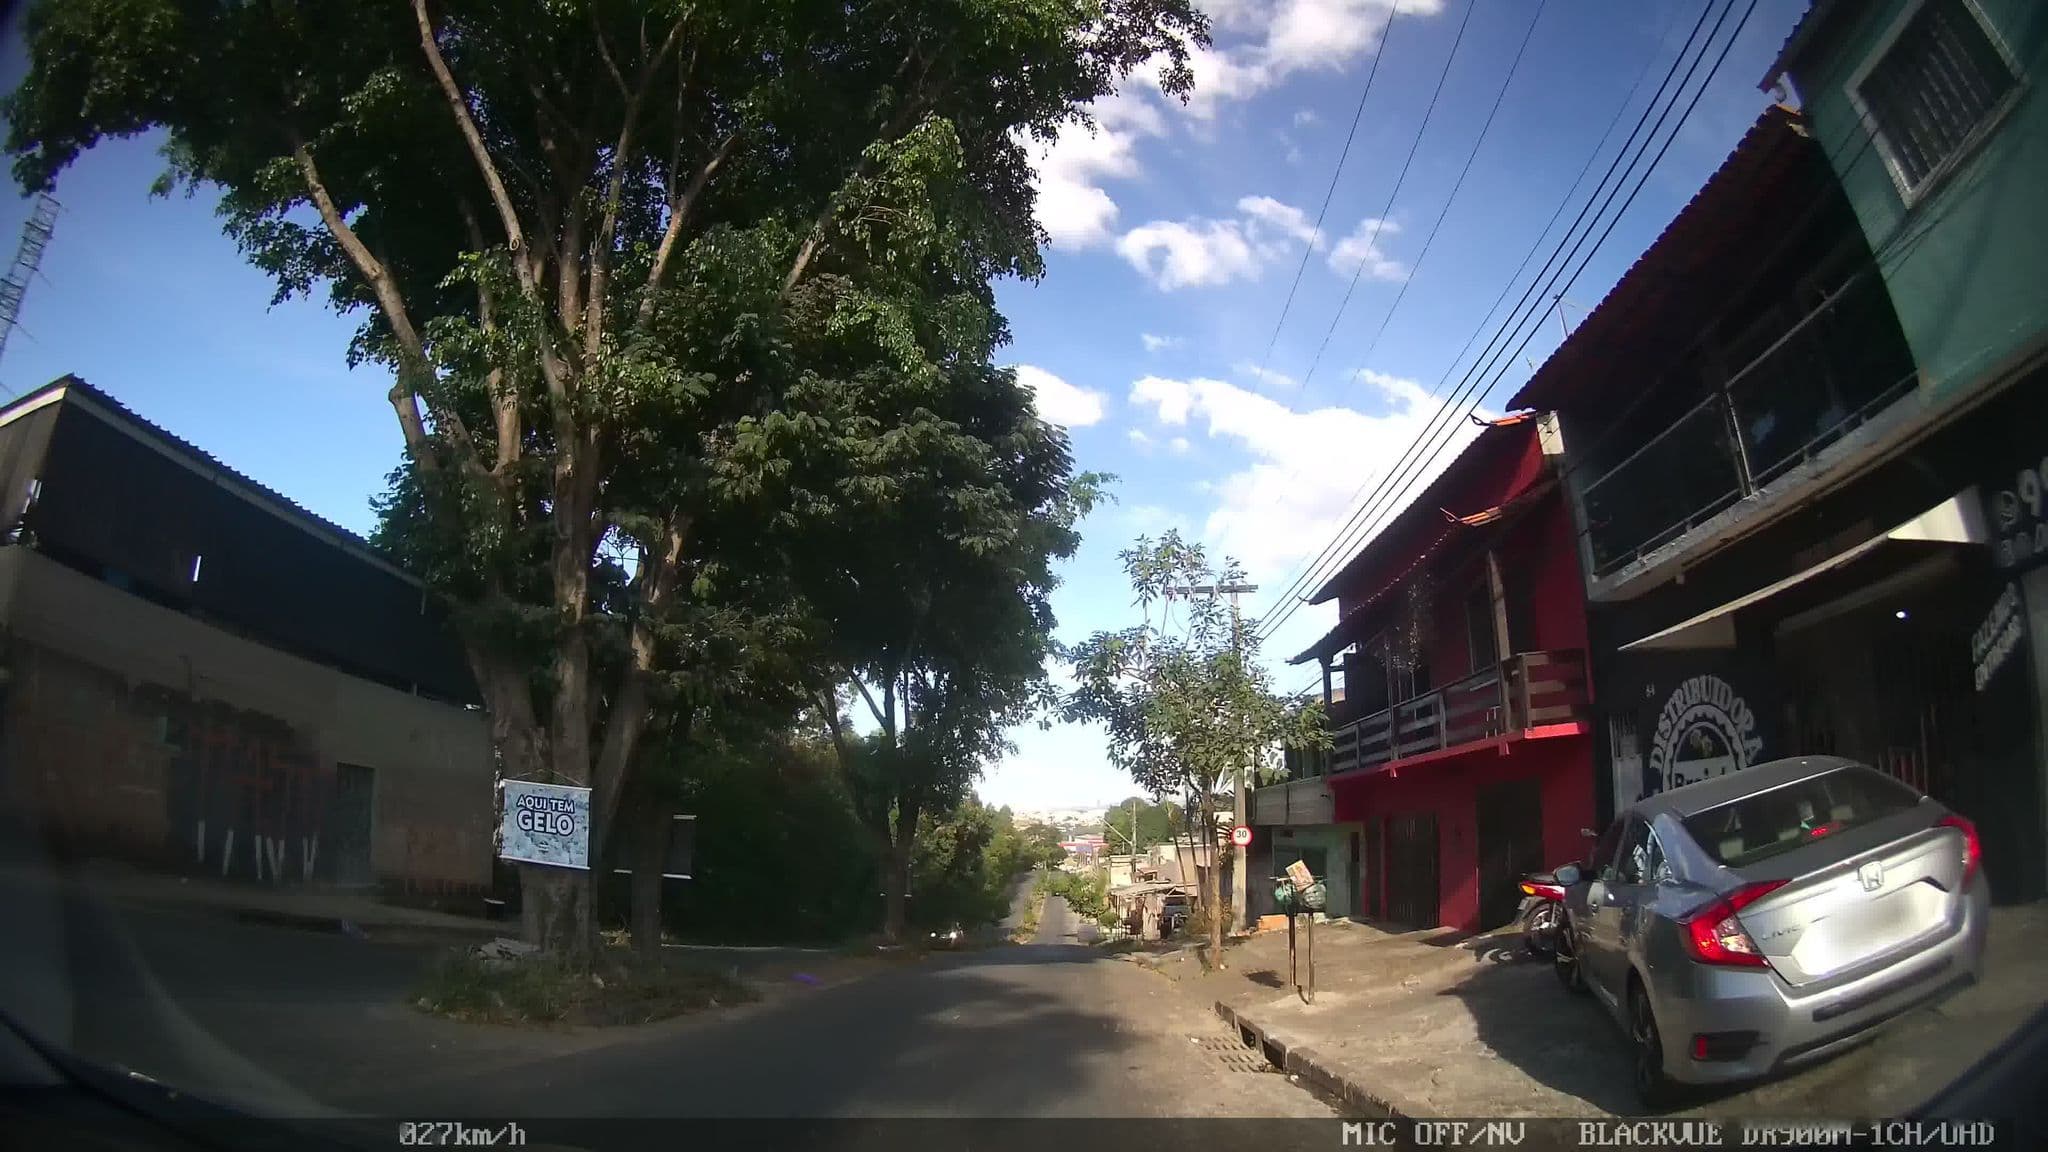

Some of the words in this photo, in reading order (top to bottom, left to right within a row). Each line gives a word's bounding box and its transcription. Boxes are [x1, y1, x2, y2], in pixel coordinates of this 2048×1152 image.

[1649, 674, 1763, 769] DISTRIBUIDORA
[517, 795, 547, 810] AQUI
[550, 799, 574, 813] TEM
[517, 809, 574, 836] GELO
[1236, 830, 1247, 838] 30
